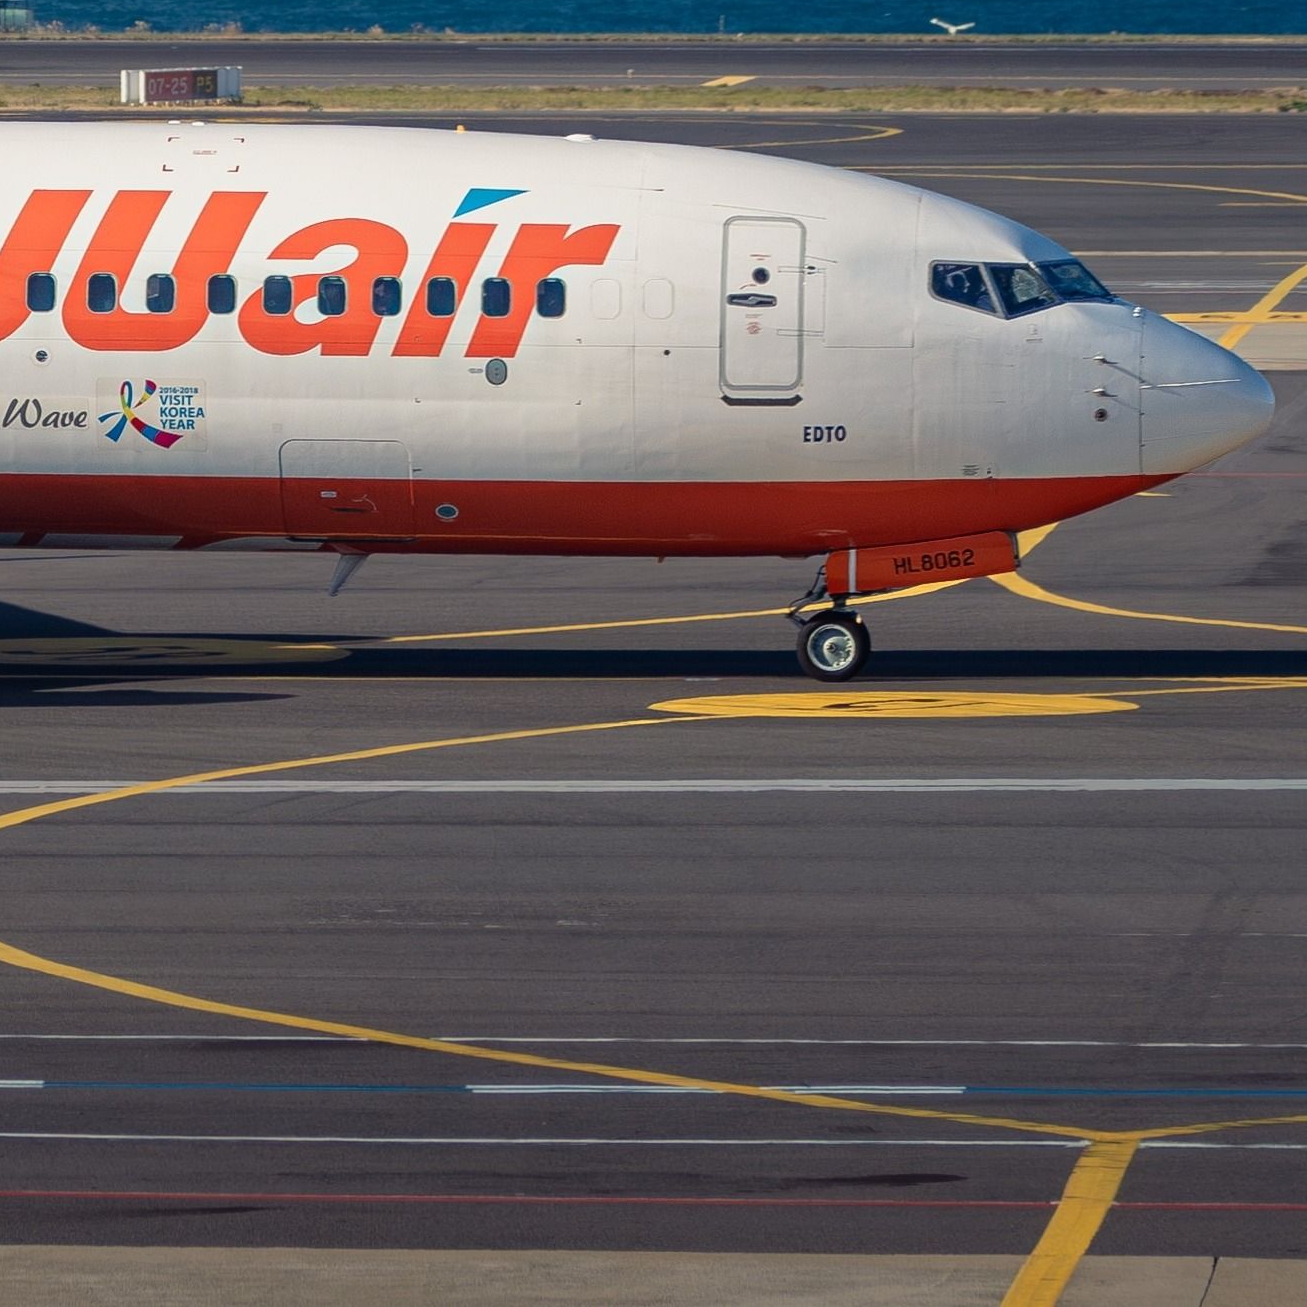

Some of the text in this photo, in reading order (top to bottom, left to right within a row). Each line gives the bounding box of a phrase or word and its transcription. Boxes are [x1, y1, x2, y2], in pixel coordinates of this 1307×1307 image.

[148, 77, 187, 95] 07-25
[159, 386, 198, 394] 2016-2018
[160, 395, 193, 405] VISIT
[2, 398, 87, 428] Wave
[160, 407, 205, 418] KOREA
[160, 419, 195, 430] YEAR
[803, 425, 846, 442] EDTO
[893, 549, 975, 574] HL8062
